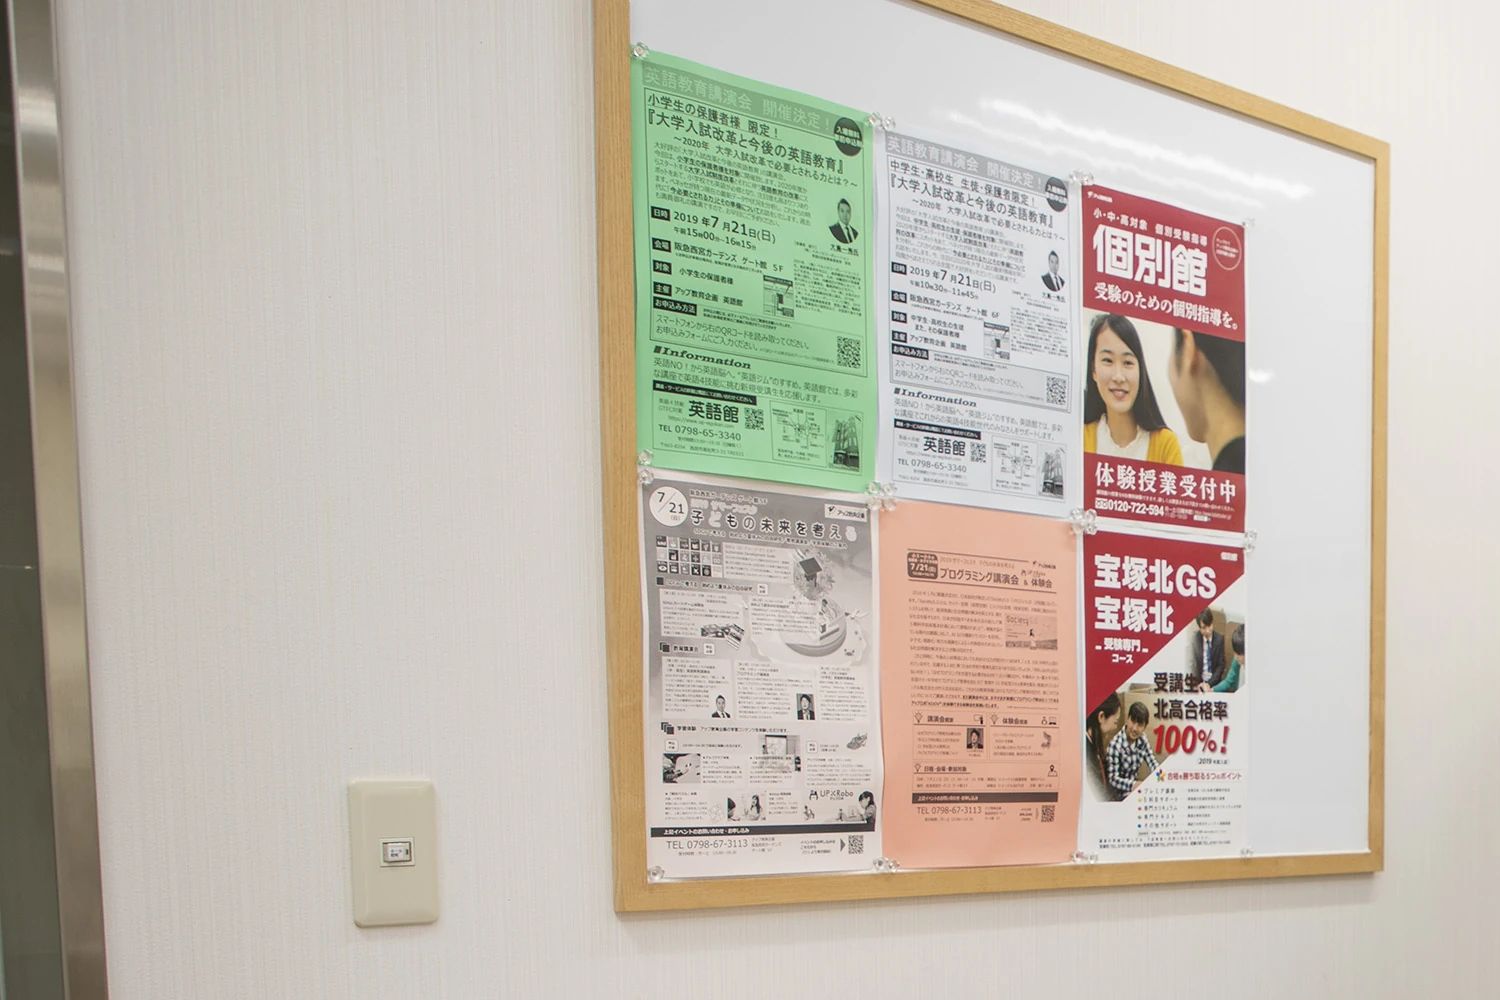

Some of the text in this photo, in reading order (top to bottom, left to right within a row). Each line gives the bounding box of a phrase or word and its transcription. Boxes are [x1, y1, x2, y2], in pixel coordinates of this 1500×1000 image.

[645, 70, 752, 110] 英語教育講演会
[648, 92, 779, 139] 小学生の保護者様 限定！
[648, 109, 844, 174] 『大学入試改革と今後の英語教育』
[890, 160, 954, 186] 中学生・高校生
[674, 211, 698, 225] 2019
[1093, 208, 1148, 231] 小・中・高対象
[1093, 223, 1207, 297] 個別館
[910, 266, 930, 278] 2019
[1094, 282, 1238, 330] 受験のための個別指導を。
[661, 346, 752, 370] Information
[902, 389, 977, 407] Information
[689, 400, 740, 424] 英語館
[658, 424, 742, 441] TEL 0798-65-3340
[923, 436, 966, 457] 英語館
[911, 459, 967, 473] 0798-65-3340
[1095, 462, 1236, 503] 体験授業受付中
[940, 568, 1019, 586] プログラミング講演会
[1094, 553, 1217, 599] 宝塚北GS
[1094, 595, 1174, 635] 宝塚北
[1104, 637, 1141, 652] 受験専門
[1112, 654, 1134, 664] コース
[1154, 698, 1228, 721] 北高合格率
[1153, 724, 1230, 755] 100%!
[931, 806, 982, 814] 0798-67-3113
[666, 839, 748, 850] TEL 0798-67-3113
